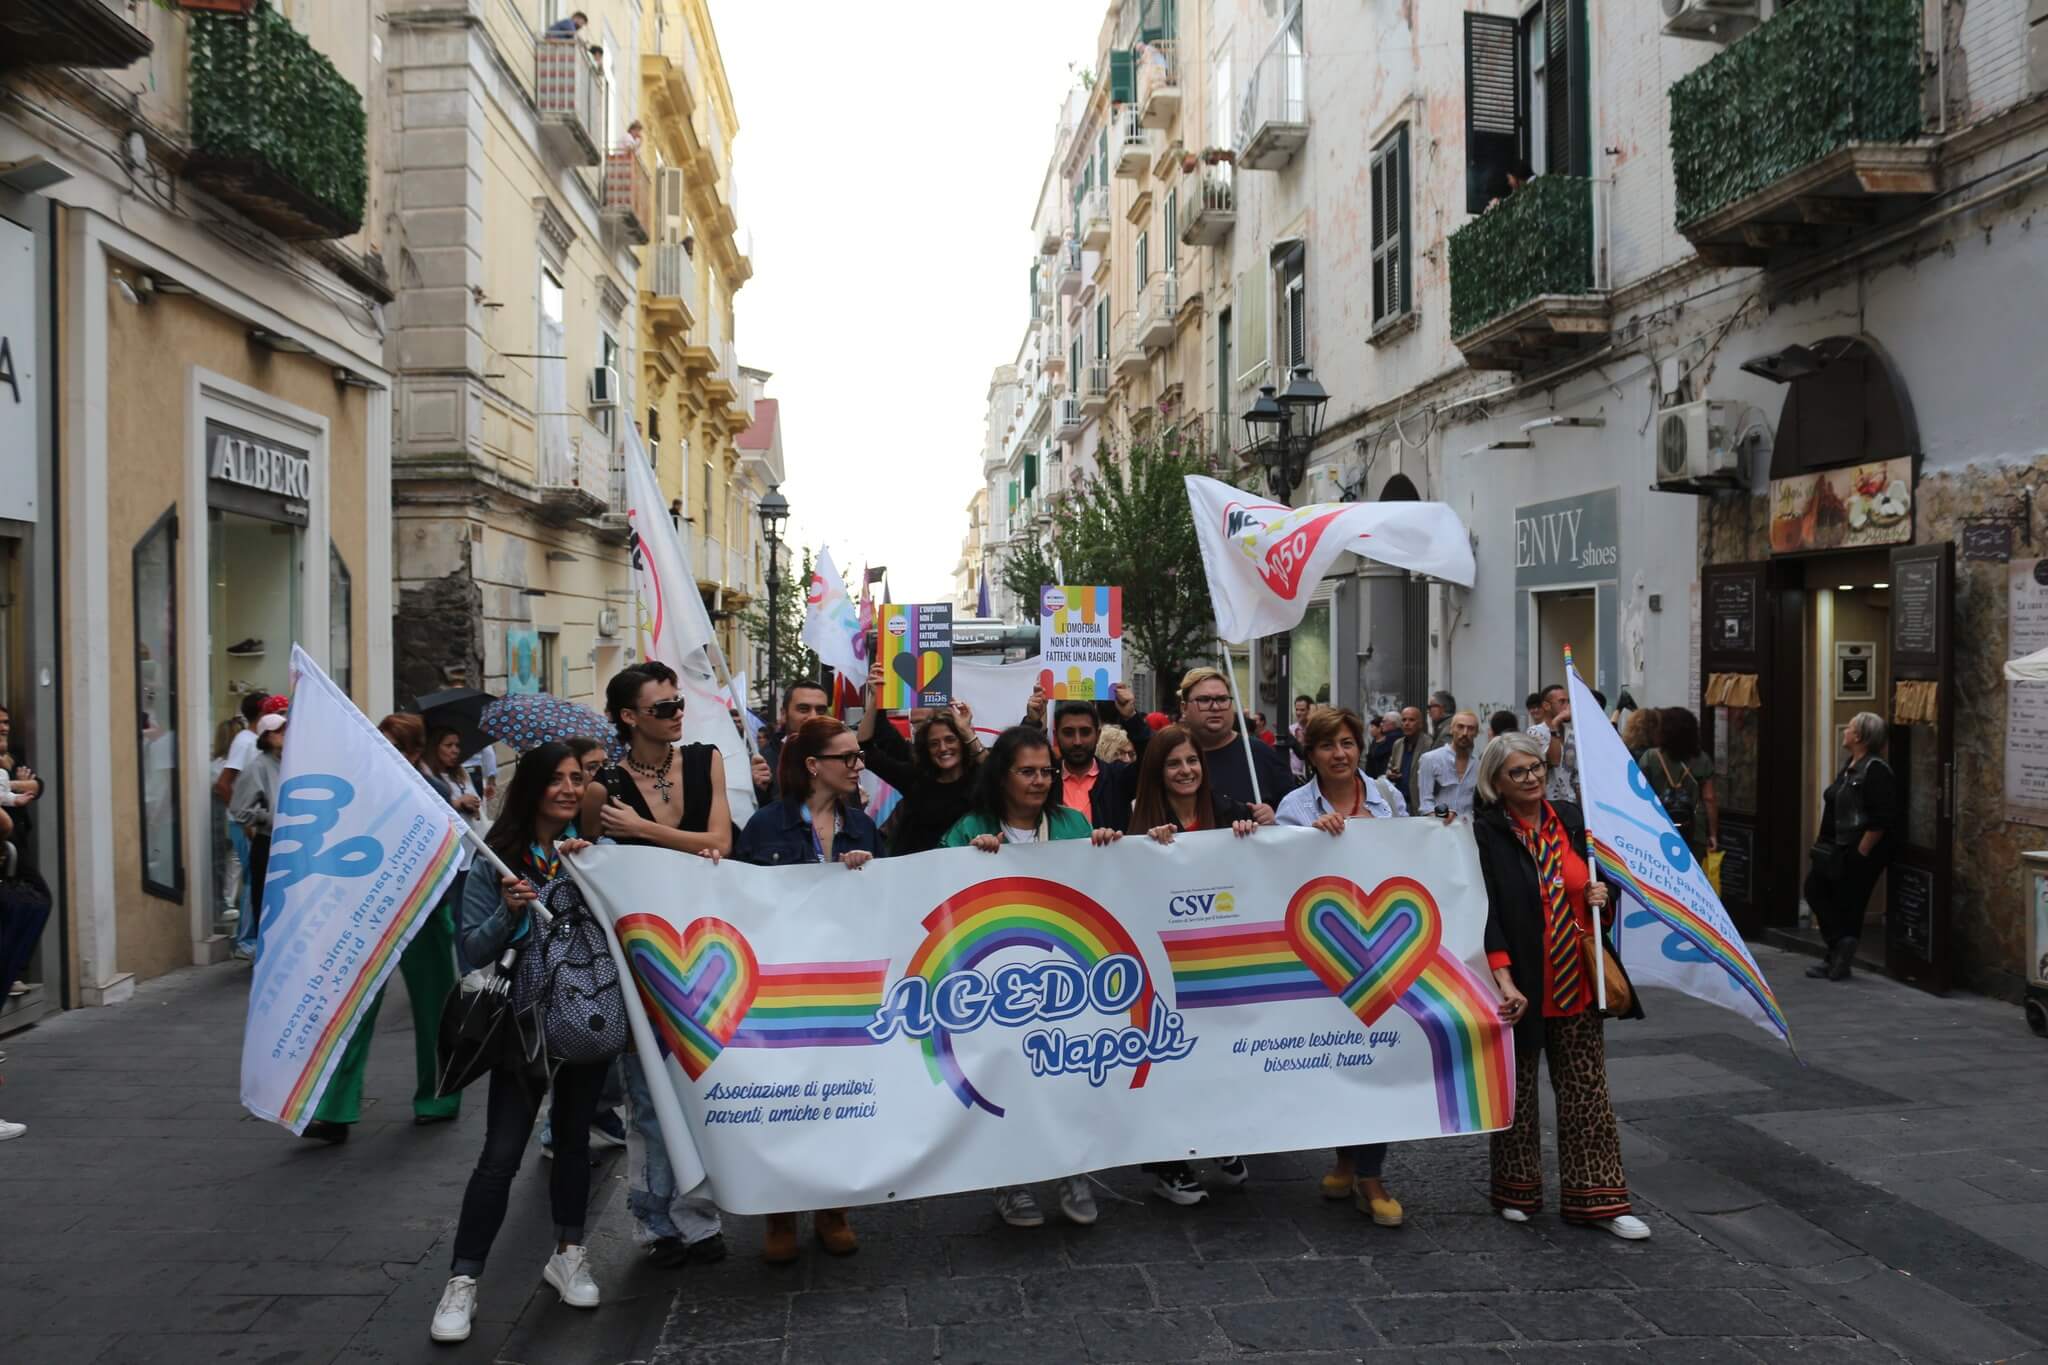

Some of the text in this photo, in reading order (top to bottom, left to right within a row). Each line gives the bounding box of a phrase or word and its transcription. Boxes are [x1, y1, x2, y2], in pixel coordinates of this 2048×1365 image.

[212, 434, 311, 500] ALBERO
[1061, 623, 1101, 634] L'OMOFOBIA
[1050, 637, 1064, 648] NON
[1071, 637, 1112, 648] UN'OPINIONE
[1046, 651, 1116, 663] FATTENE UNA RAGIONE
[1614, 835, 1674, 880] Genitori,
[1169, 893, 1216, 917] CSV
[867, 952, 1143, 1041] AGEDO
[1023, 992, 1199, 1087] Napoli
[1232, 1029, 1401, 1056] di persone lesbiche, gay,
[1264, 1052, 1376, 1073] bisessuali, trans
[704, 1078, 877, 1102] Associazione di genitori,
[704, 1101, 878, 1126] parenti, amiche e amici
